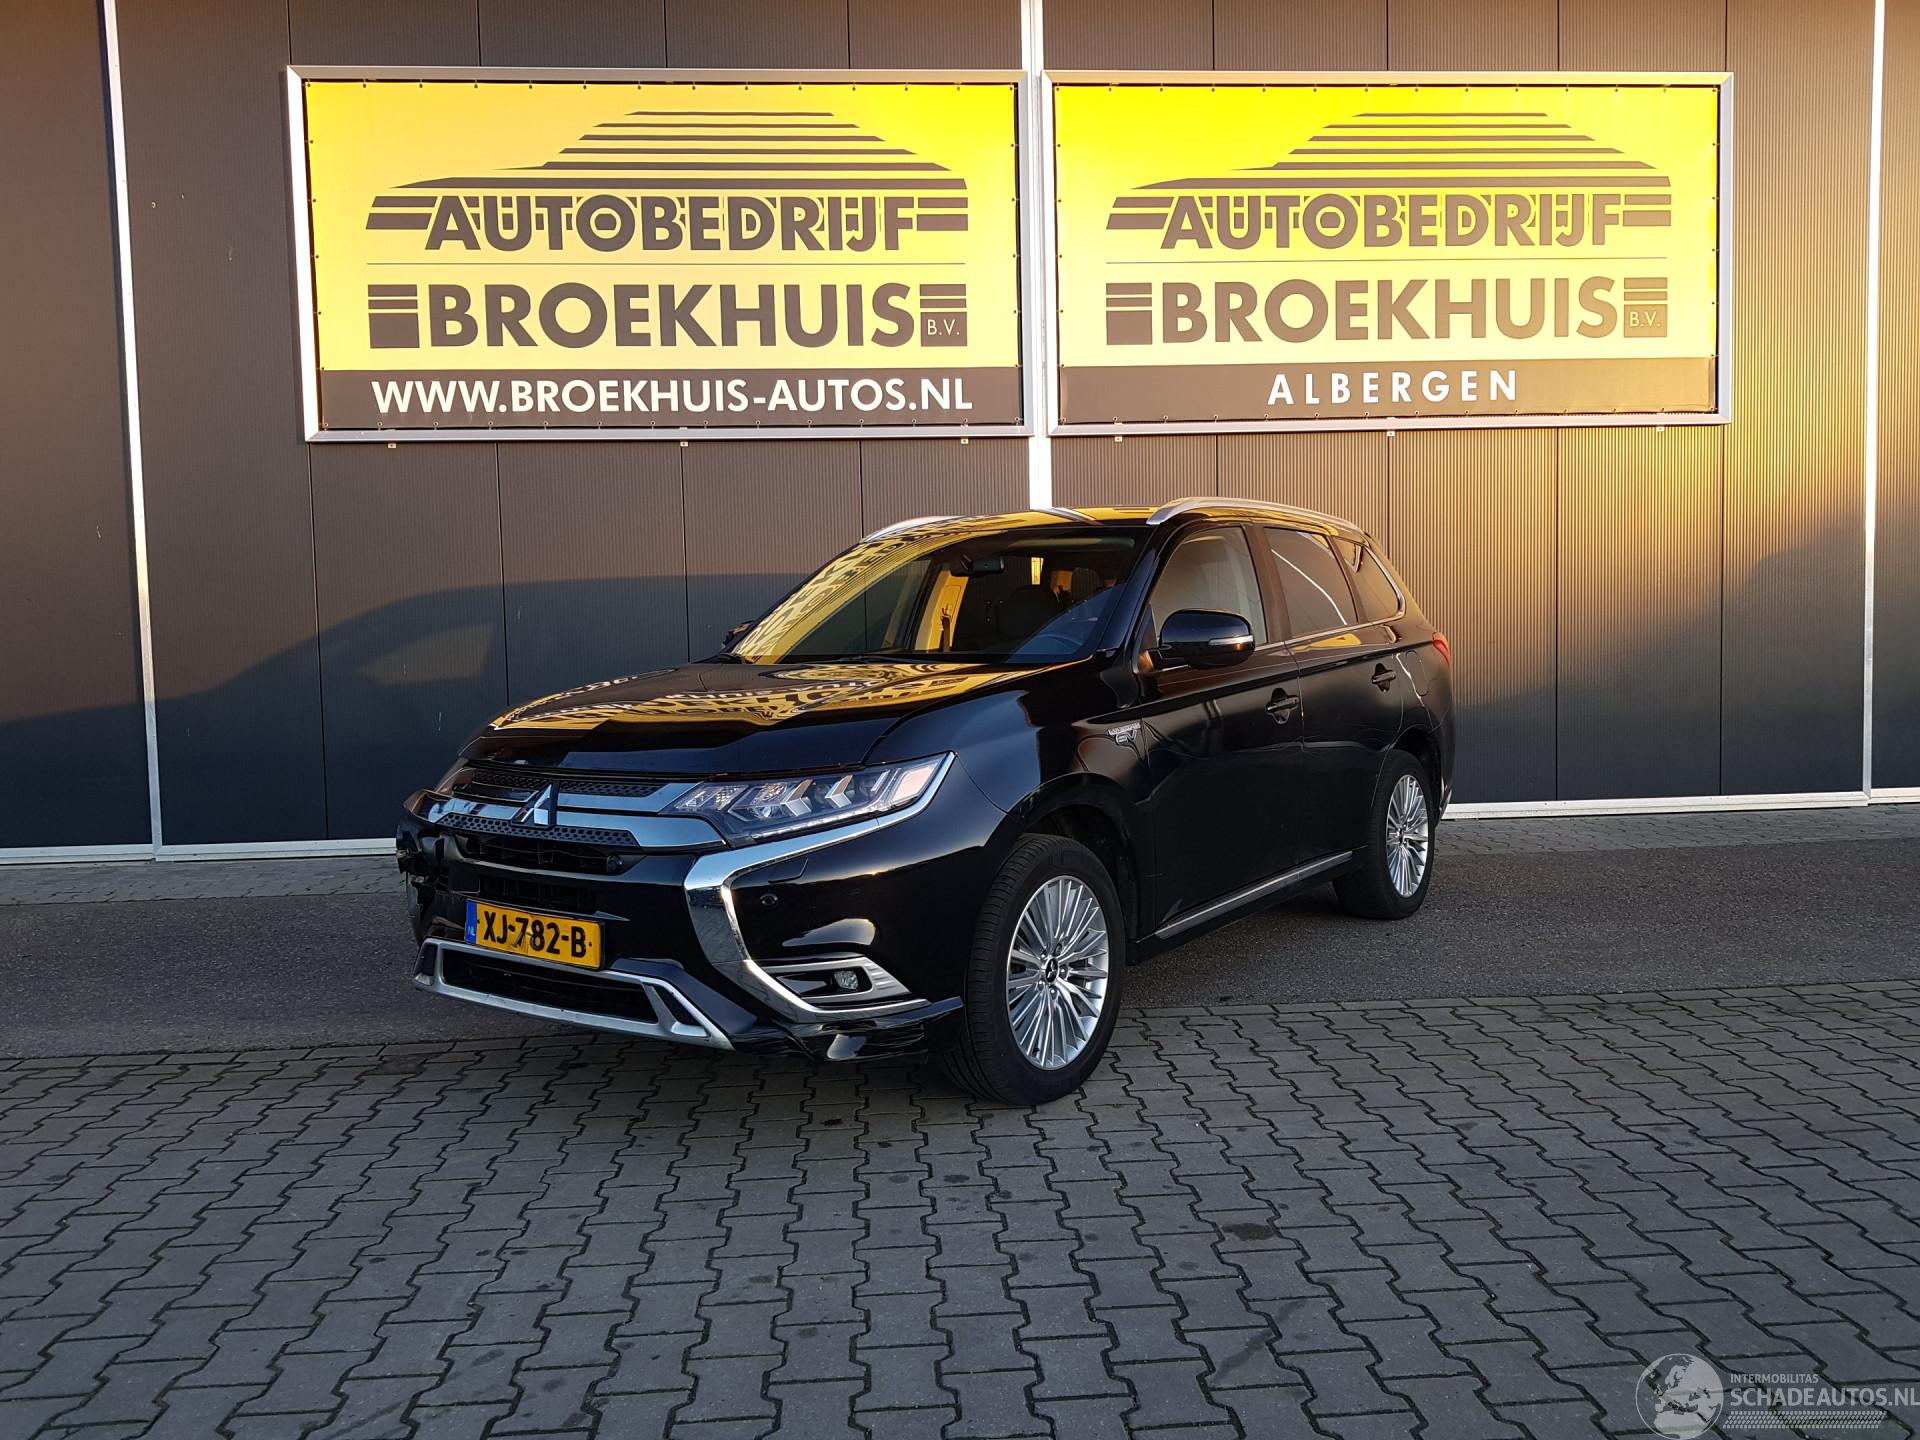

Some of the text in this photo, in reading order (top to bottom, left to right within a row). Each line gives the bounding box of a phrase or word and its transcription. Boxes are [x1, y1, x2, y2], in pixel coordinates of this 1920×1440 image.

[425, 195, 915, 252] AUTOBEDRIJF
[1160, 193, 1622, 250] AUTOBEDRIJF
[429, 283, 960, 348] BROEKHUIS B.V.
[1162, 277, 1661, 343] BROEKHUIS B.V.
[371, 378, 973, 413] WWW.BROEKHUIS-AUTOS.NL
[1267, 371, 1516, 404] ALBERGEN
[484, 911, 587, 957] XJ-782-B
